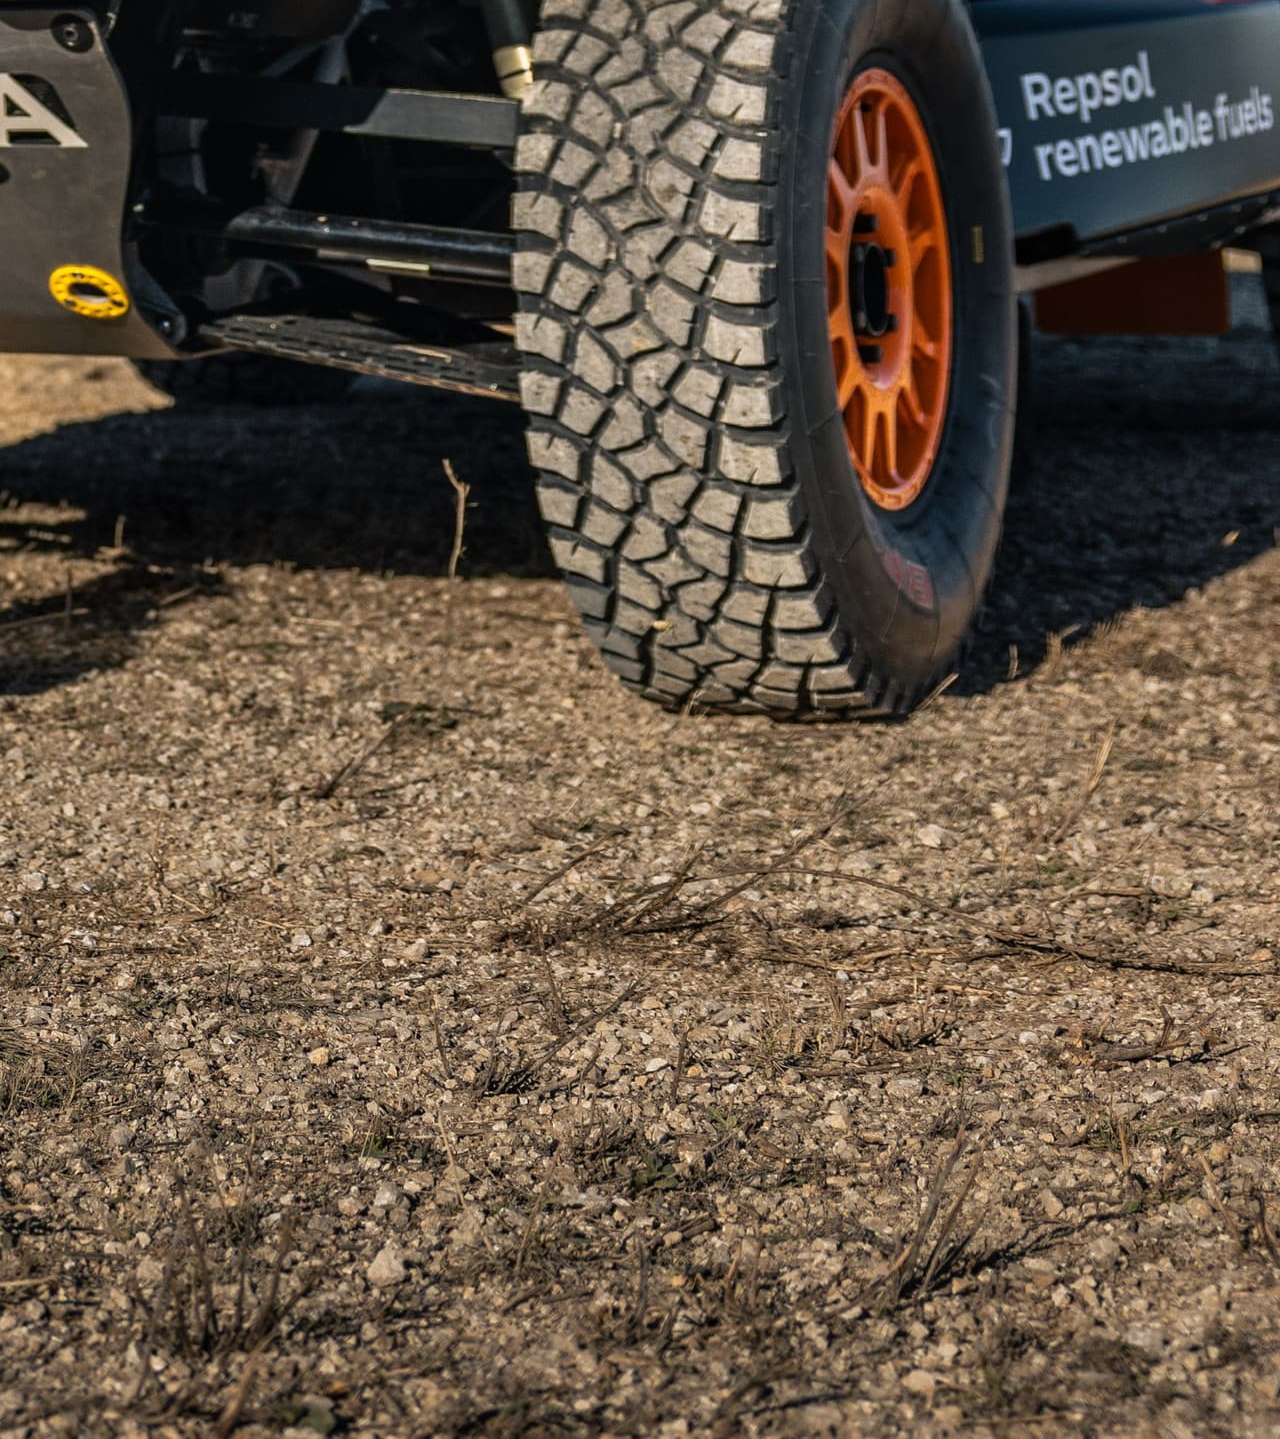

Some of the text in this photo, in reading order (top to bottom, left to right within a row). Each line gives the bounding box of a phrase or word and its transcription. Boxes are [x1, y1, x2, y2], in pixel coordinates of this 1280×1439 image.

[1020, 50, 1156, 124] Repsol
[1034, 86, 1275, 181] renewable fuels
